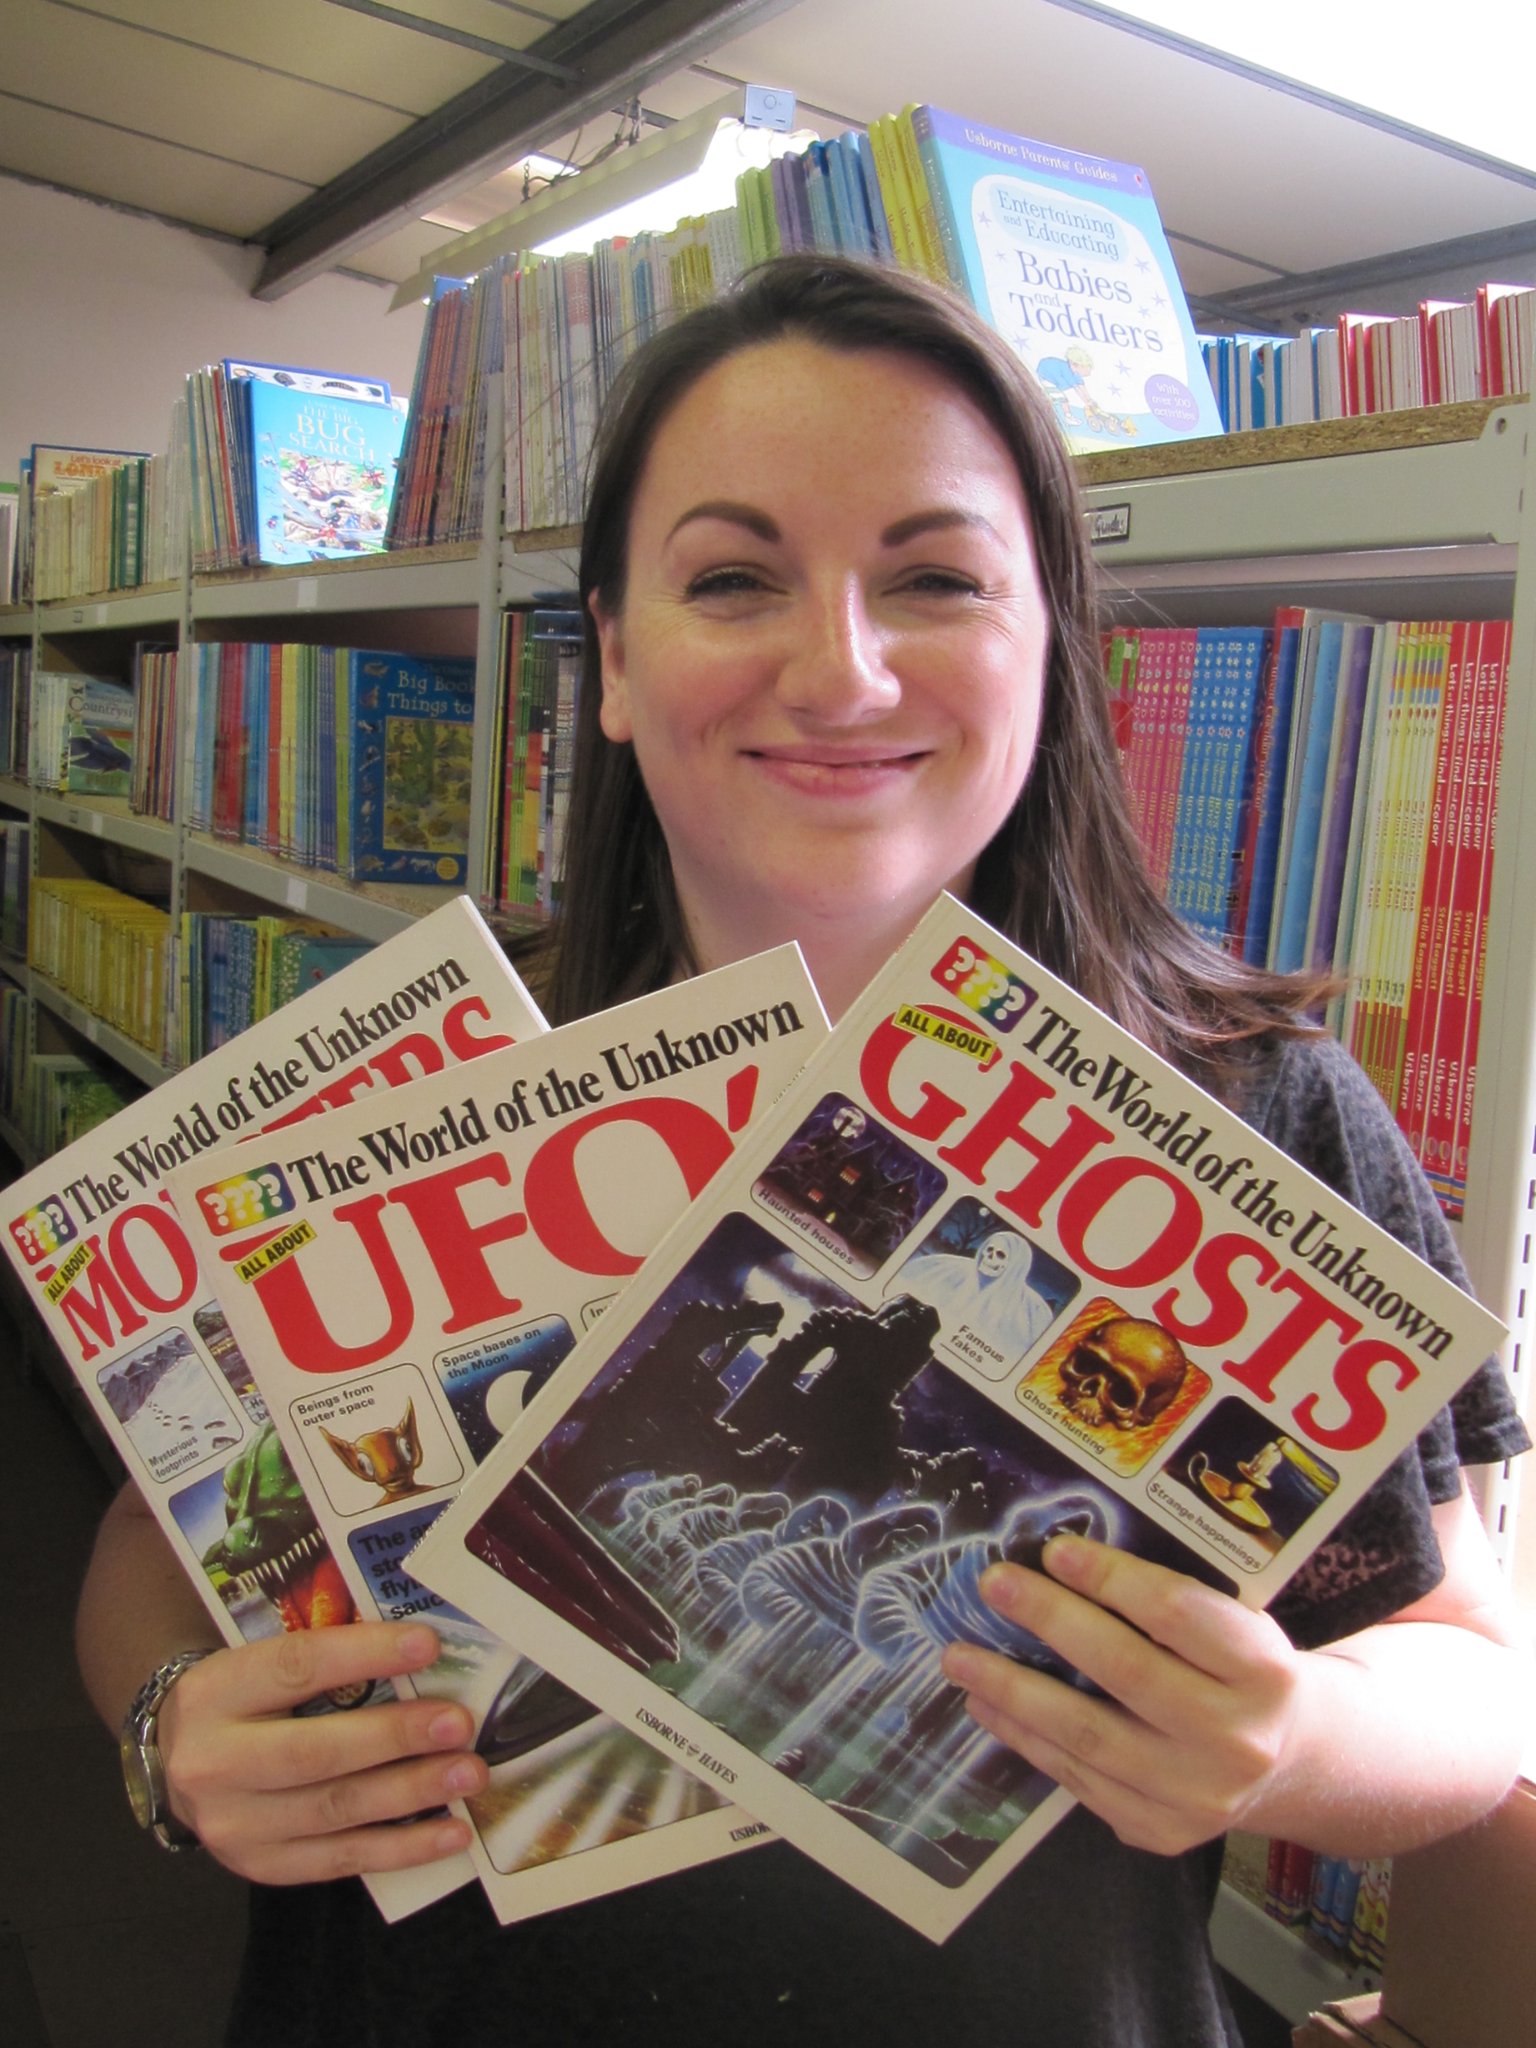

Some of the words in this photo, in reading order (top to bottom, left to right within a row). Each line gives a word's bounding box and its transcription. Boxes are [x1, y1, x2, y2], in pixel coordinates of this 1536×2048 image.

[965, 129, 1018, 157] Usborne
[1074, 159, 1117, 183] Guides
[997, 190, 1116, 240] Entertaining
[1003, 214, 1022, 227] and
[1026, 219, 1119, 261] Educating
[1015, 249, 1132, 304] Babies
[1034, 291, 1061, 308] and
[1009, 292, 1163, 353] Toddlers
[289, 432, 375, 462] SEARCH
[297, 413, 366, 447] BUG
[397, 670, 428, 695] Big
[1447, 663, 1458, 690] Lots
[1463, 662, 1474, 689] Lots
[1478, 663, 1489, 690] Lots
[1487, 662, 1498, 690] Lots
[387, 692, 448, 718] Things
[454, 699, 472, 714] to
[1442, 704, 1454, 743] things
[1458, 703, 1470, 742] things
[1472, 704, 1484, 744] things
[1482, 704, 1494, 744] things
[1436, 756, 1448, 782] find
[1452, 755, 1464, 782] find
[1467, 757, 1479, 784] find
[1476, 757, 1490, 785] find
[1420, 906, 1430, 939] Stella
[1435, 906, 1446, 939] Stella
[1451, 909, 1462, 943] Stella
[1462, 912, 1474, 945] Stella
[1414, 942, 1426, 989] Baggott
[1429, 942, 1442, 990] Baggott
[1446, 946, 1458, 994] Baggott
[1457, 948, 1470, 997] Baggott
[900, 1009, 929, 1033] ALL
[933, 1022, 993, 1058] ABOUT
[63, 1173, 129, 1224] The
[113, 1102, 220, 1188] World
[217, 1077, 255, 1131] of
[249, 1061, 309, 1109] the
[294, 960, 470, 1073] Unknown
[1398, 1051, 1415, 1109] Usborne
[1415, 1052, 1429, 1111] Usborne
[1432, 1058, 1446, 1116] Usborne
[1444, 1061, 1458, 1119] Usborne
[1464, 1065, 1477, 1126] Usborne
[286, 1151, 371, 1203] The
[358, 1097, 491, 1175] World
[494, 1079, 536, 1132] of
[535, 1067, 604, 1118] the
[601, 1000, 804, 1093] Unknown
[1022, 1006, 1098, 1088] The
[1092, 1055, 1213, 1167] World
[1194, 1157, 1254, 1195] of
[1230, 1177, 1295, 1238] the
[1290, 1210, 1454, 1361] Unknown
[758, 1189, 811, 1232] Haunted
[811, 1227, 854, 1265] houses
[860, 1003, 1420, 1452] GHOSTS
[240, 1255, 268, 1281] ALL
[264, 1224, 312, 1263] ABOUT
[47, 1274, 65, 1302] ALL
[60, 1246, 91, 1284] ABOUT
[441, 1348, 481, 1368] Space
[483, 1334, 521, 1354] bases
[524, 1328, 542, 1340] on
[950, 1335, 984, 1364] fakes
[958, 1324, 1005, 1364] Famous
[446, 1364, 470, 1380] the
[471, 1352, 510, 1373] Moon
[297, 1390, 341, 1416] Beings
[342, 1382, 375, 1401] from
[301, 1405, 337, 1428] outer
[339, 1396, 377, 1418] space
[1022, 1388, 1059, 1421] Ghost
[1060, 1411, 1105, 1454] hunting
[148, 1435, 199, 1468] Mysterious
[155, 1449, 200, 1479] footprints
[357, 1531, 406, 1555] The
[1149, 1482, 1196, 1524] Strange
[1196, 1510, 1262, 1570] happenings
[635, 1707, 689, 1750] USBORNE
[698, 1752, 738, 1784] HAYES
